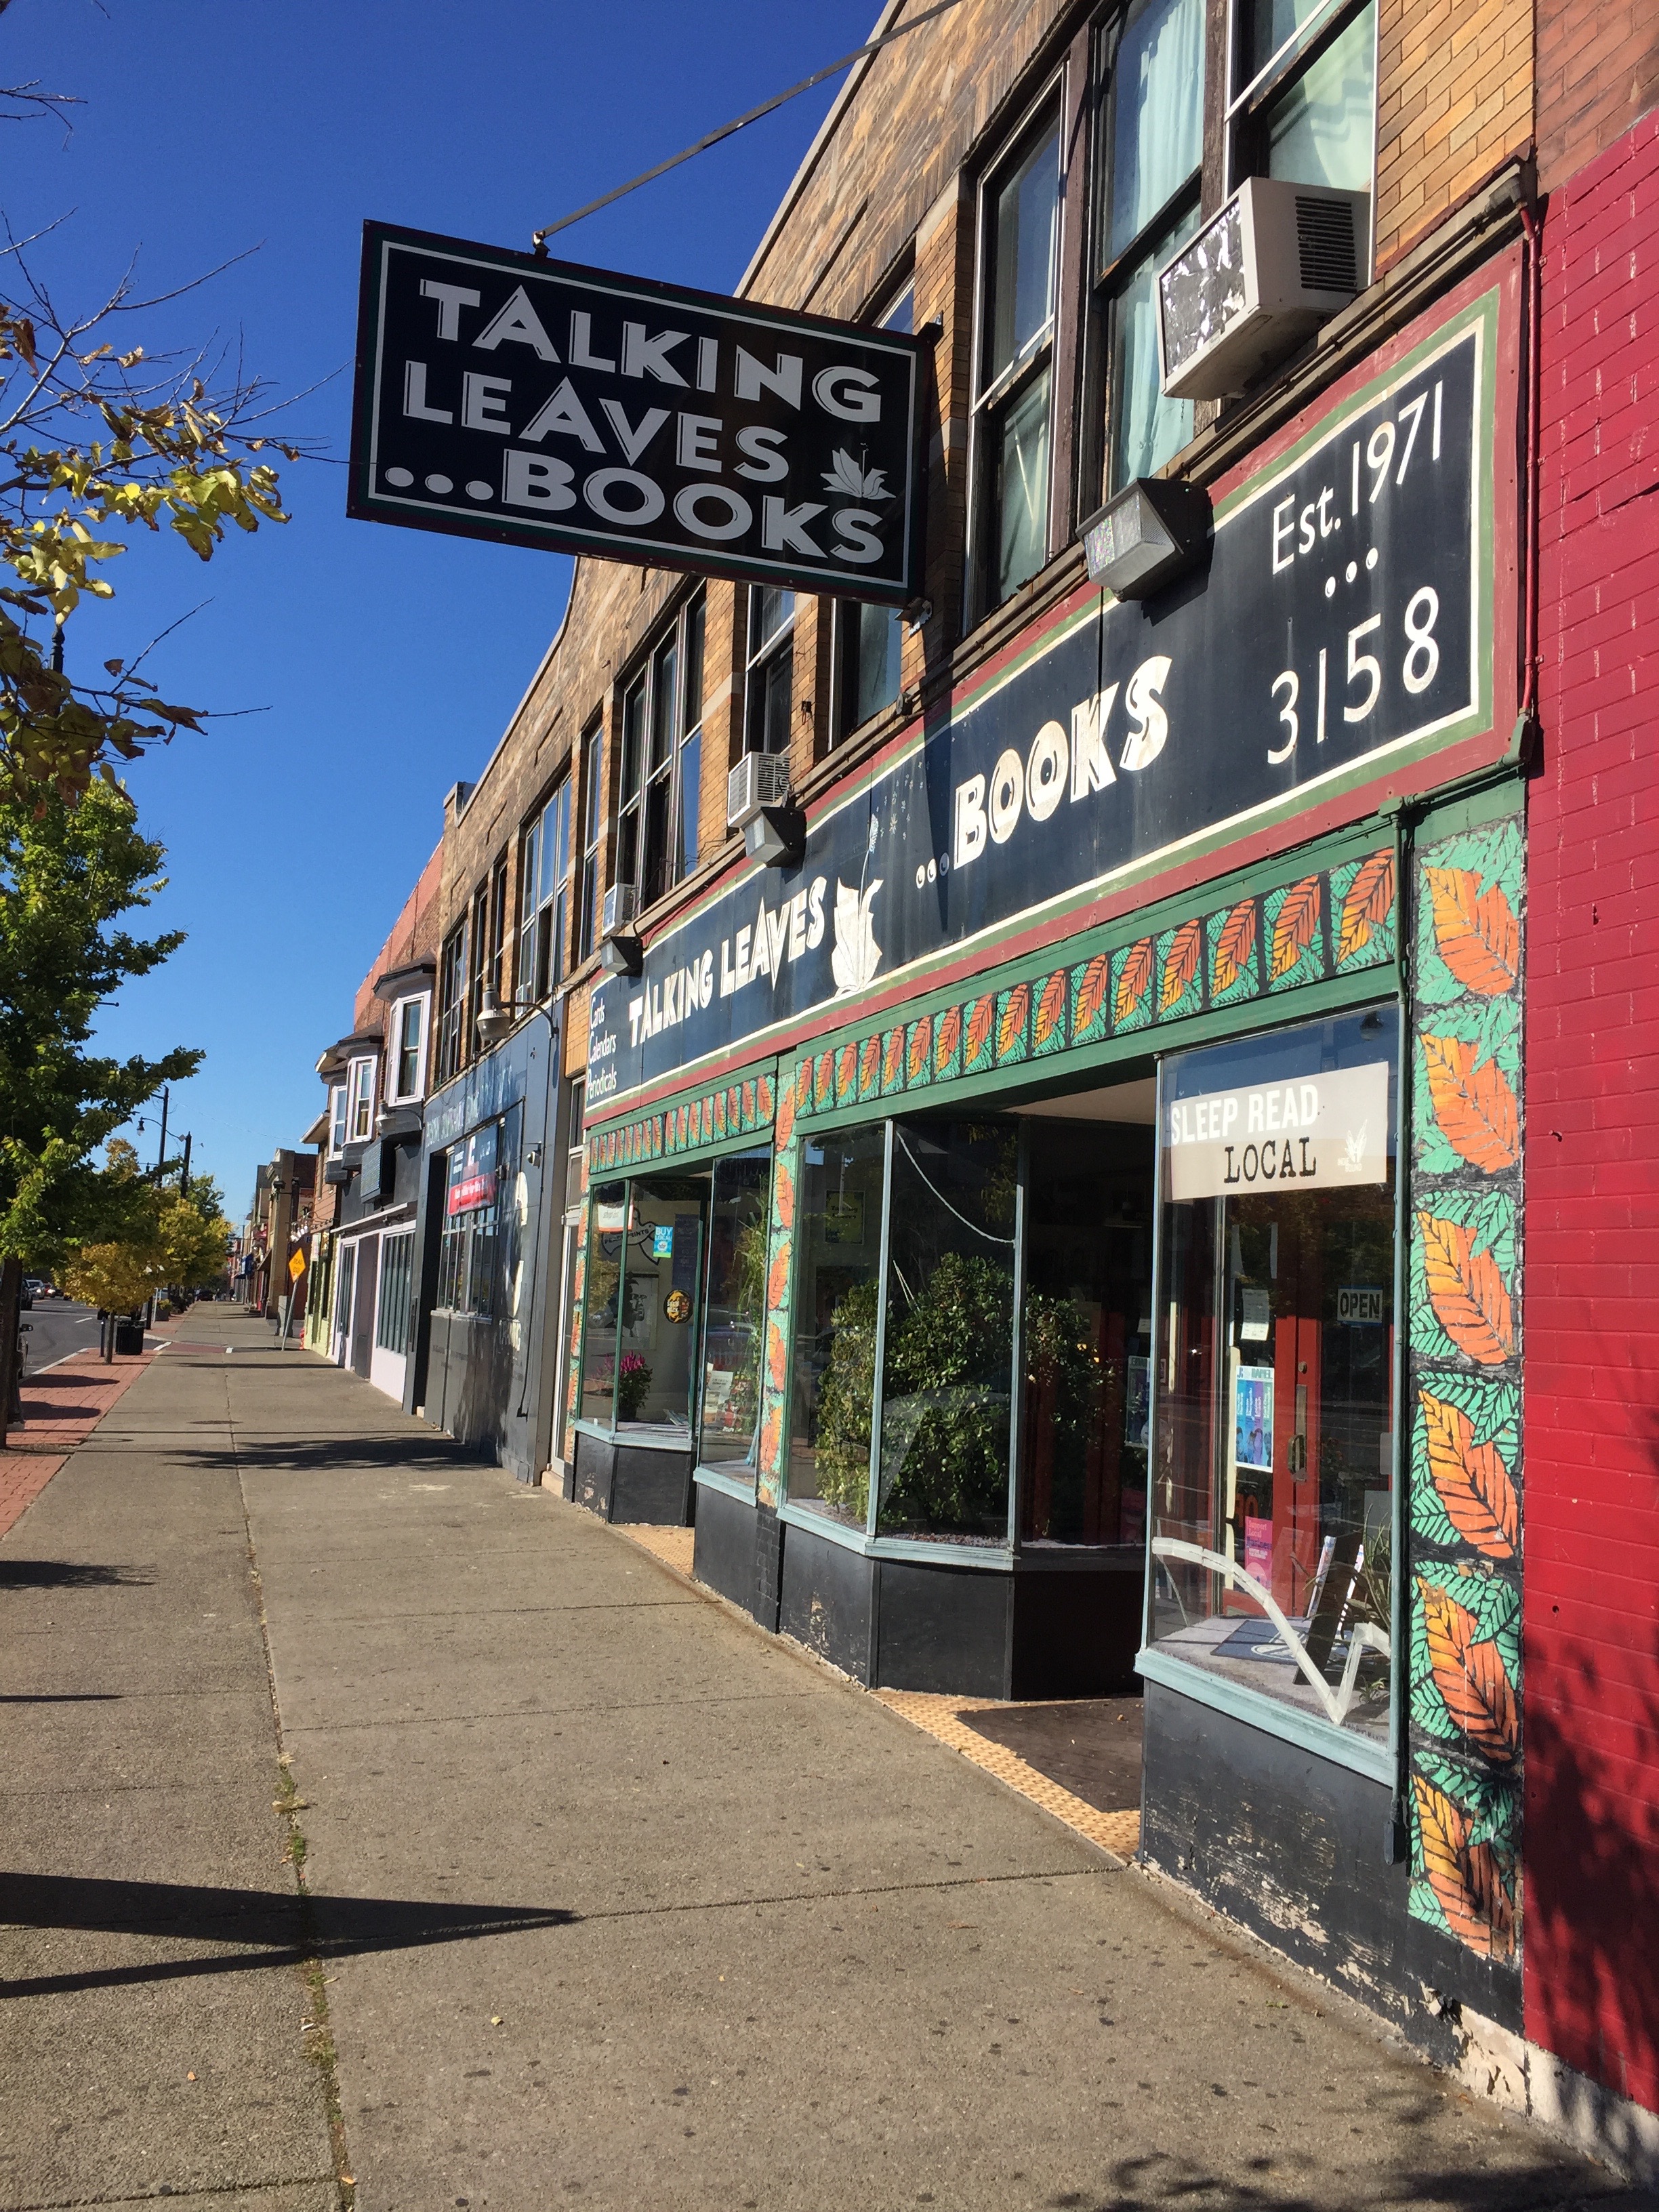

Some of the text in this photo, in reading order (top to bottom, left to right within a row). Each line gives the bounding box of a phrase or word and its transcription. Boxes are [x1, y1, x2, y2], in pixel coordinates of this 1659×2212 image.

[419, 279, 882, 423] TALKING
[403, 360, 789, 482] LEAVES
[1272, 380, 1443, 575] Est. 1971
[1267, 586, 1441, 764] 3158
[629, 950, 714, 1048] TALKING
[720, 876, 827, 998] LEAVES
[590, 996, 605, 1030] Cards
[589, 1029, 617, 1065] Calendars
[586, 1063, 617, 1101] Periodicals
[1171, 1084, 1318, 1145] SLEEP READ
[1224, 1137, 1316, 1184] LOCAL
[655, 1227, 673, 1235] BUY
[1340, 1292, 1380, 1318] OPEN
